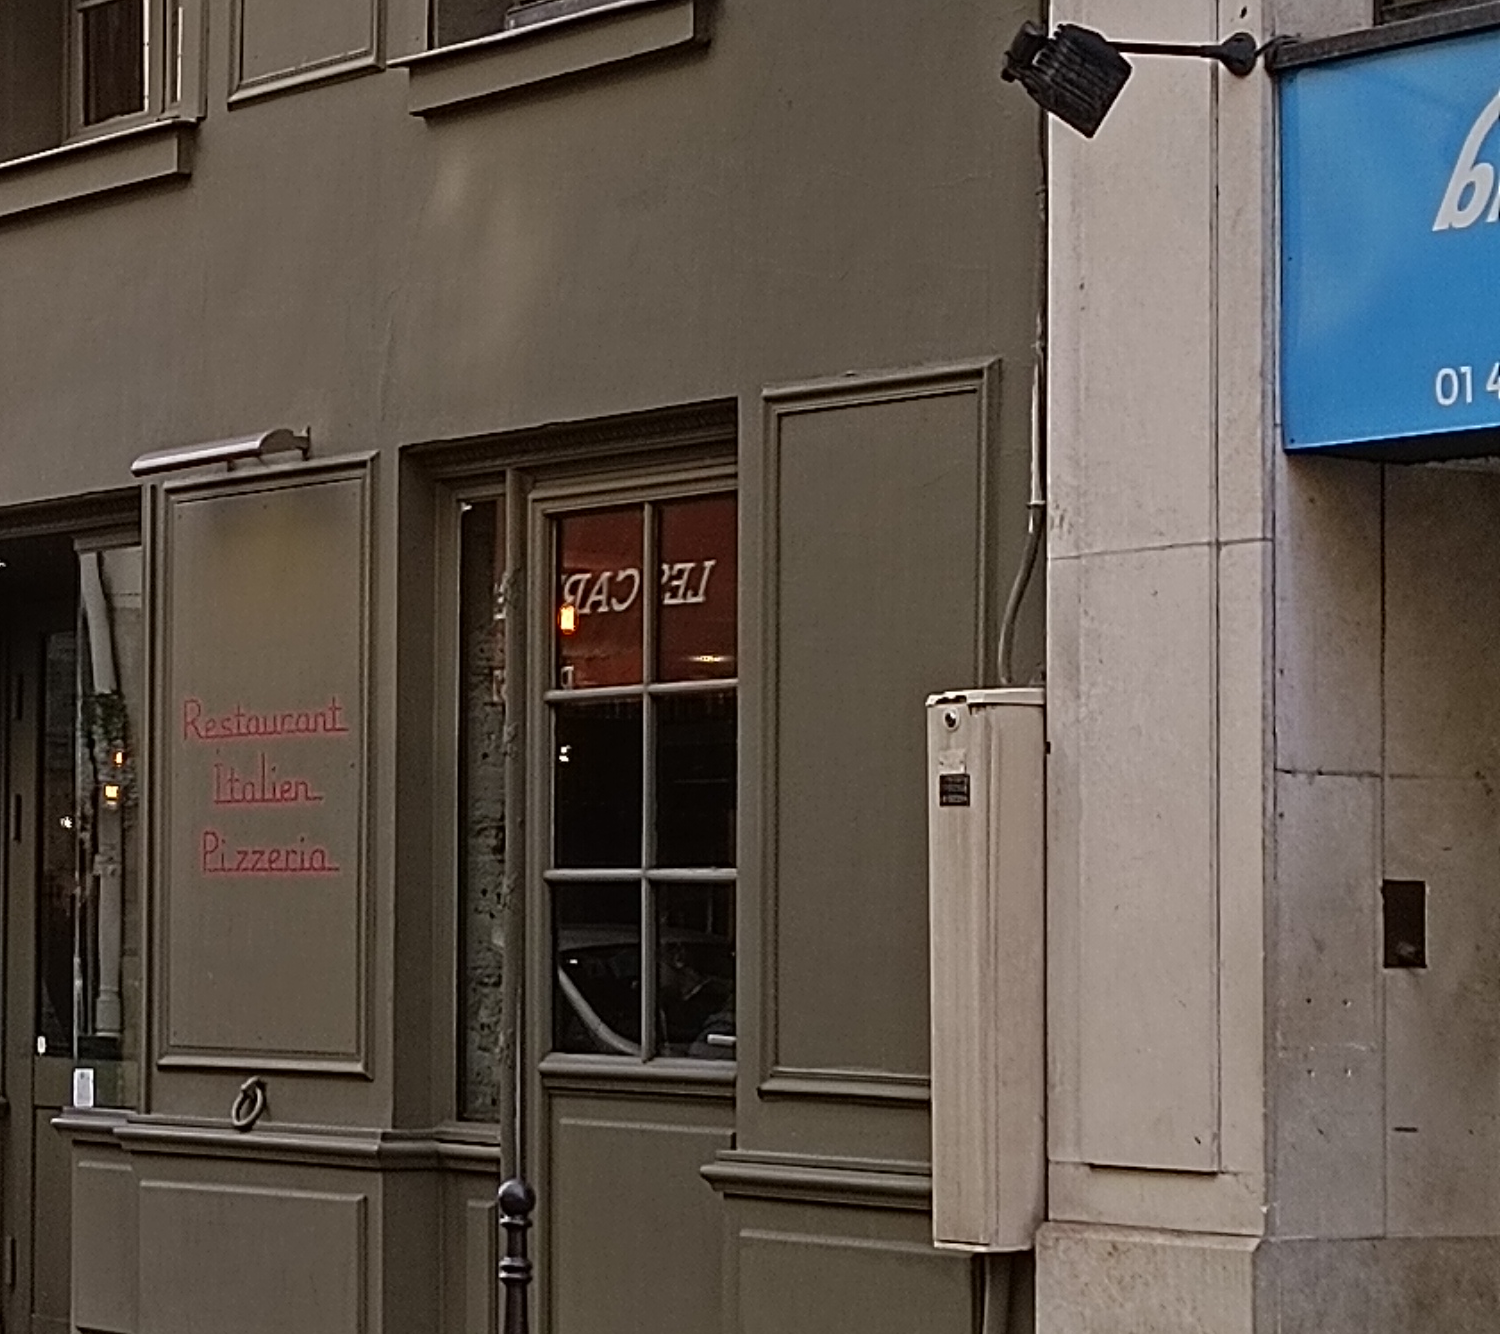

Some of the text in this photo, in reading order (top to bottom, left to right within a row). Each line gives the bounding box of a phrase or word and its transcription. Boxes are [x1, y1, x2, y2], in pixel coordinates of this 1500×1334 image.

[1435, 366, 1472, 406] 01
[182, 695, 350, 741] Restaurant
[212, 748, 326, 805] Italien
[201, 829, 342, 875] Pizzeria
